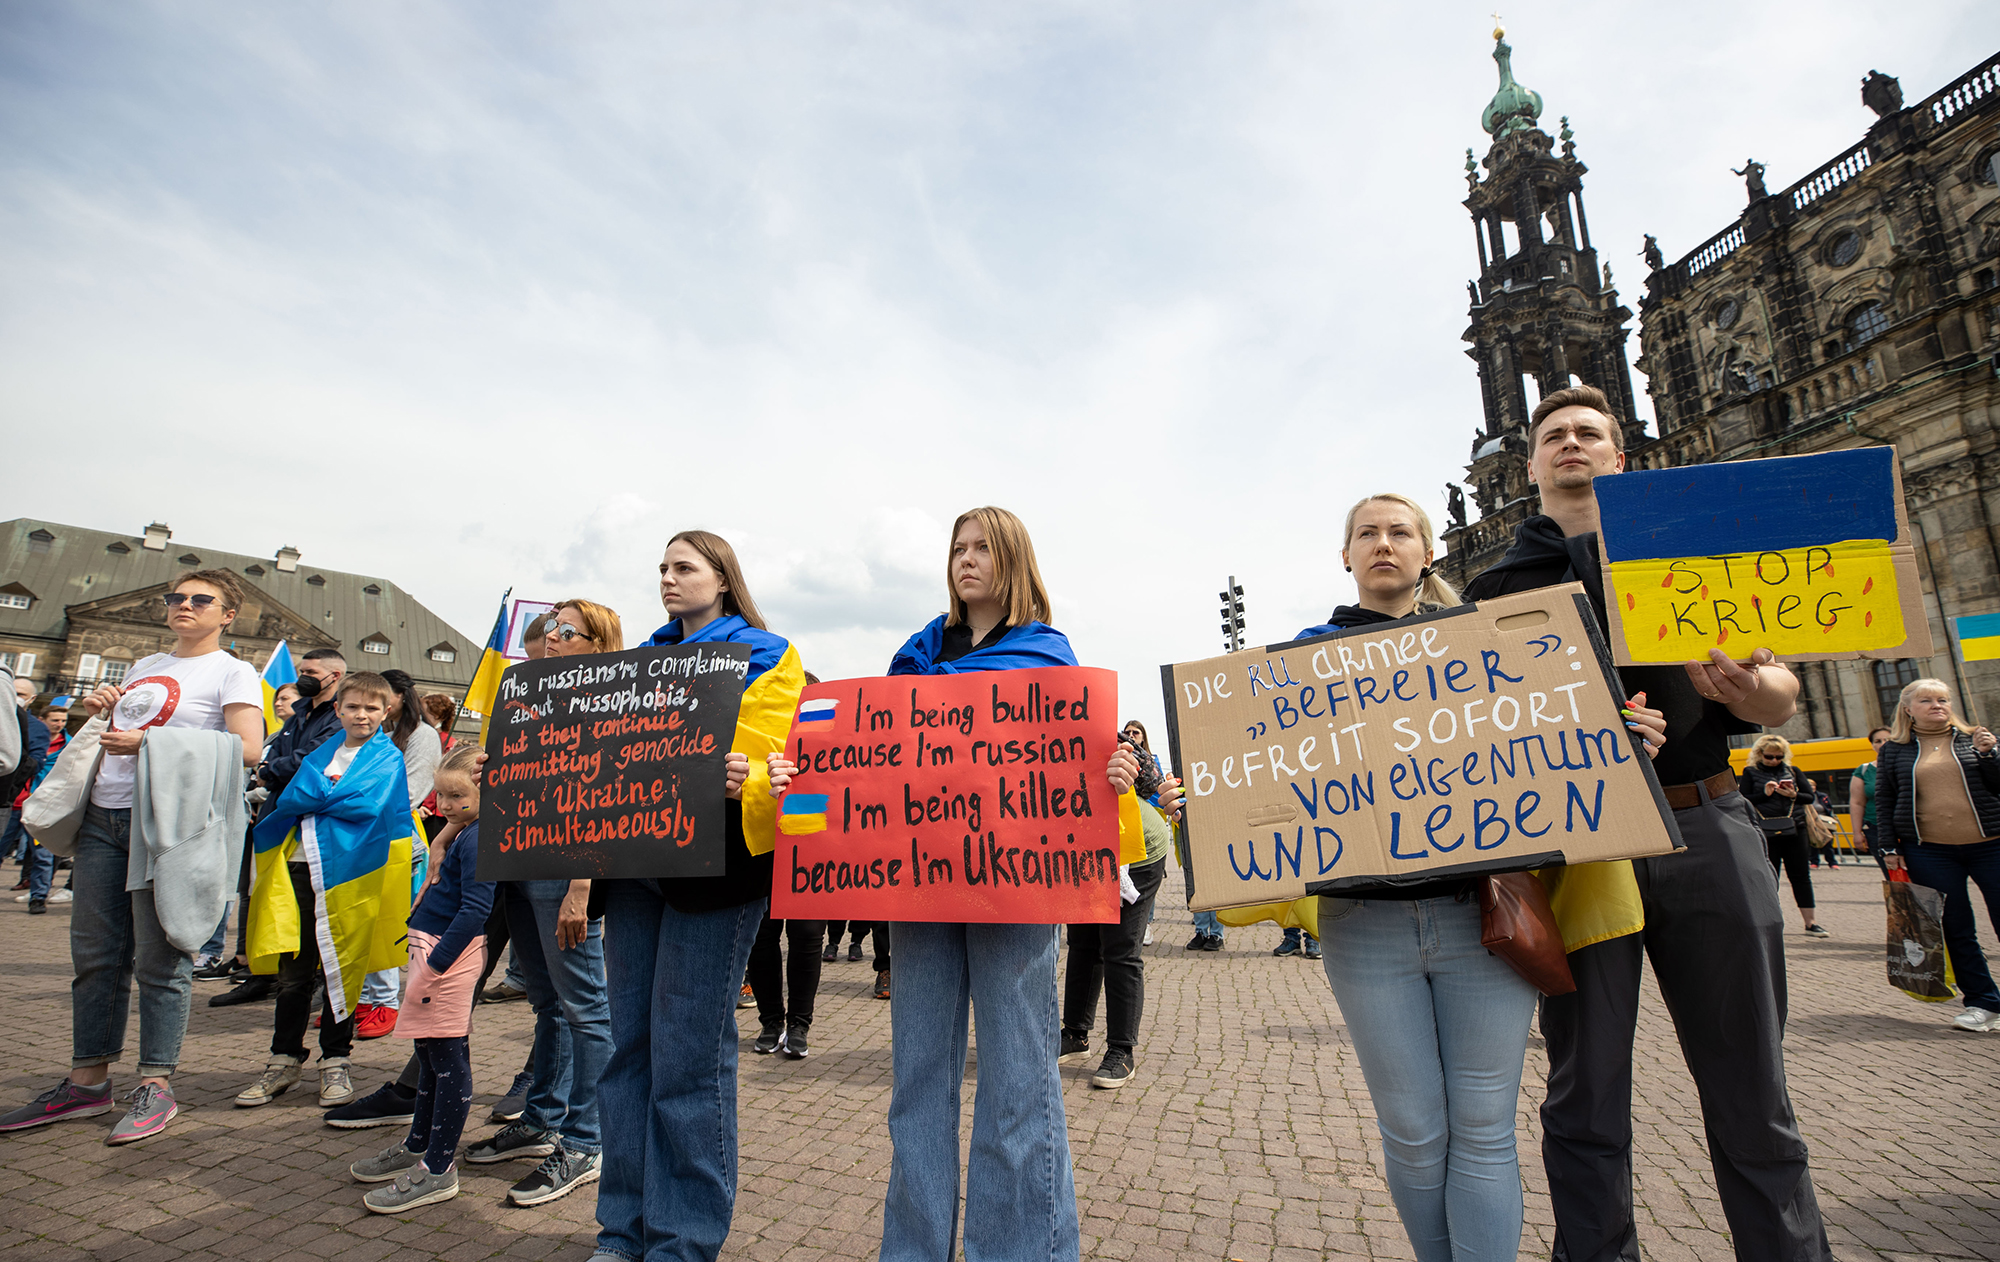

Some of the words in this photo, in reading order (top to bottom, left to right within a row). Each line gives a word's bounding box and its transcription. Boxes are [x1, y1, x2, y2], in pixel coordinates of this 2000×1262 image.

[1669, 547, 1832, 594] STOP
[502, 673, 528, 700] The
[538, 660, 638, 692] russians're
[648, 648, 750, 680] complaining
[510, 701, 554, 724] about
[569, 680, 699, 715] russophobia,
[855, 687, 894, 732] I'm
[910, 688, 975, 736] being
[992, 682, 1089, 724] bullied
[1393, 681, 1588, 752] SOFORT
[488, 749, 602, 784] committing
[615, 727, 718, 770] genocide
[503, 730, 528, 757] but
[537, 723, 581, 751] they
[592, 710, 684, 740] continue
[795, 738, 902, 776] because
[916, 732, 954, 768] I'm
[971, 733, 1086, 767] russian
[517, 793, 537, 818] in
[553, 778, 664, 814] Ukraine
[843, 787, 888, 834] I'm
[904, 783, 982, 833] being
[999, 770, 1093, 820] killed
[1290, 770, 1375, 821] VON
[500, 799, 696, 853] simultaneously
[791, 845, 903, 894] because
[911, 837, 954, 888] I'm
[962, 831, 1119, 890] Ukrainian
[1227, 825, 1343, 883] UND
